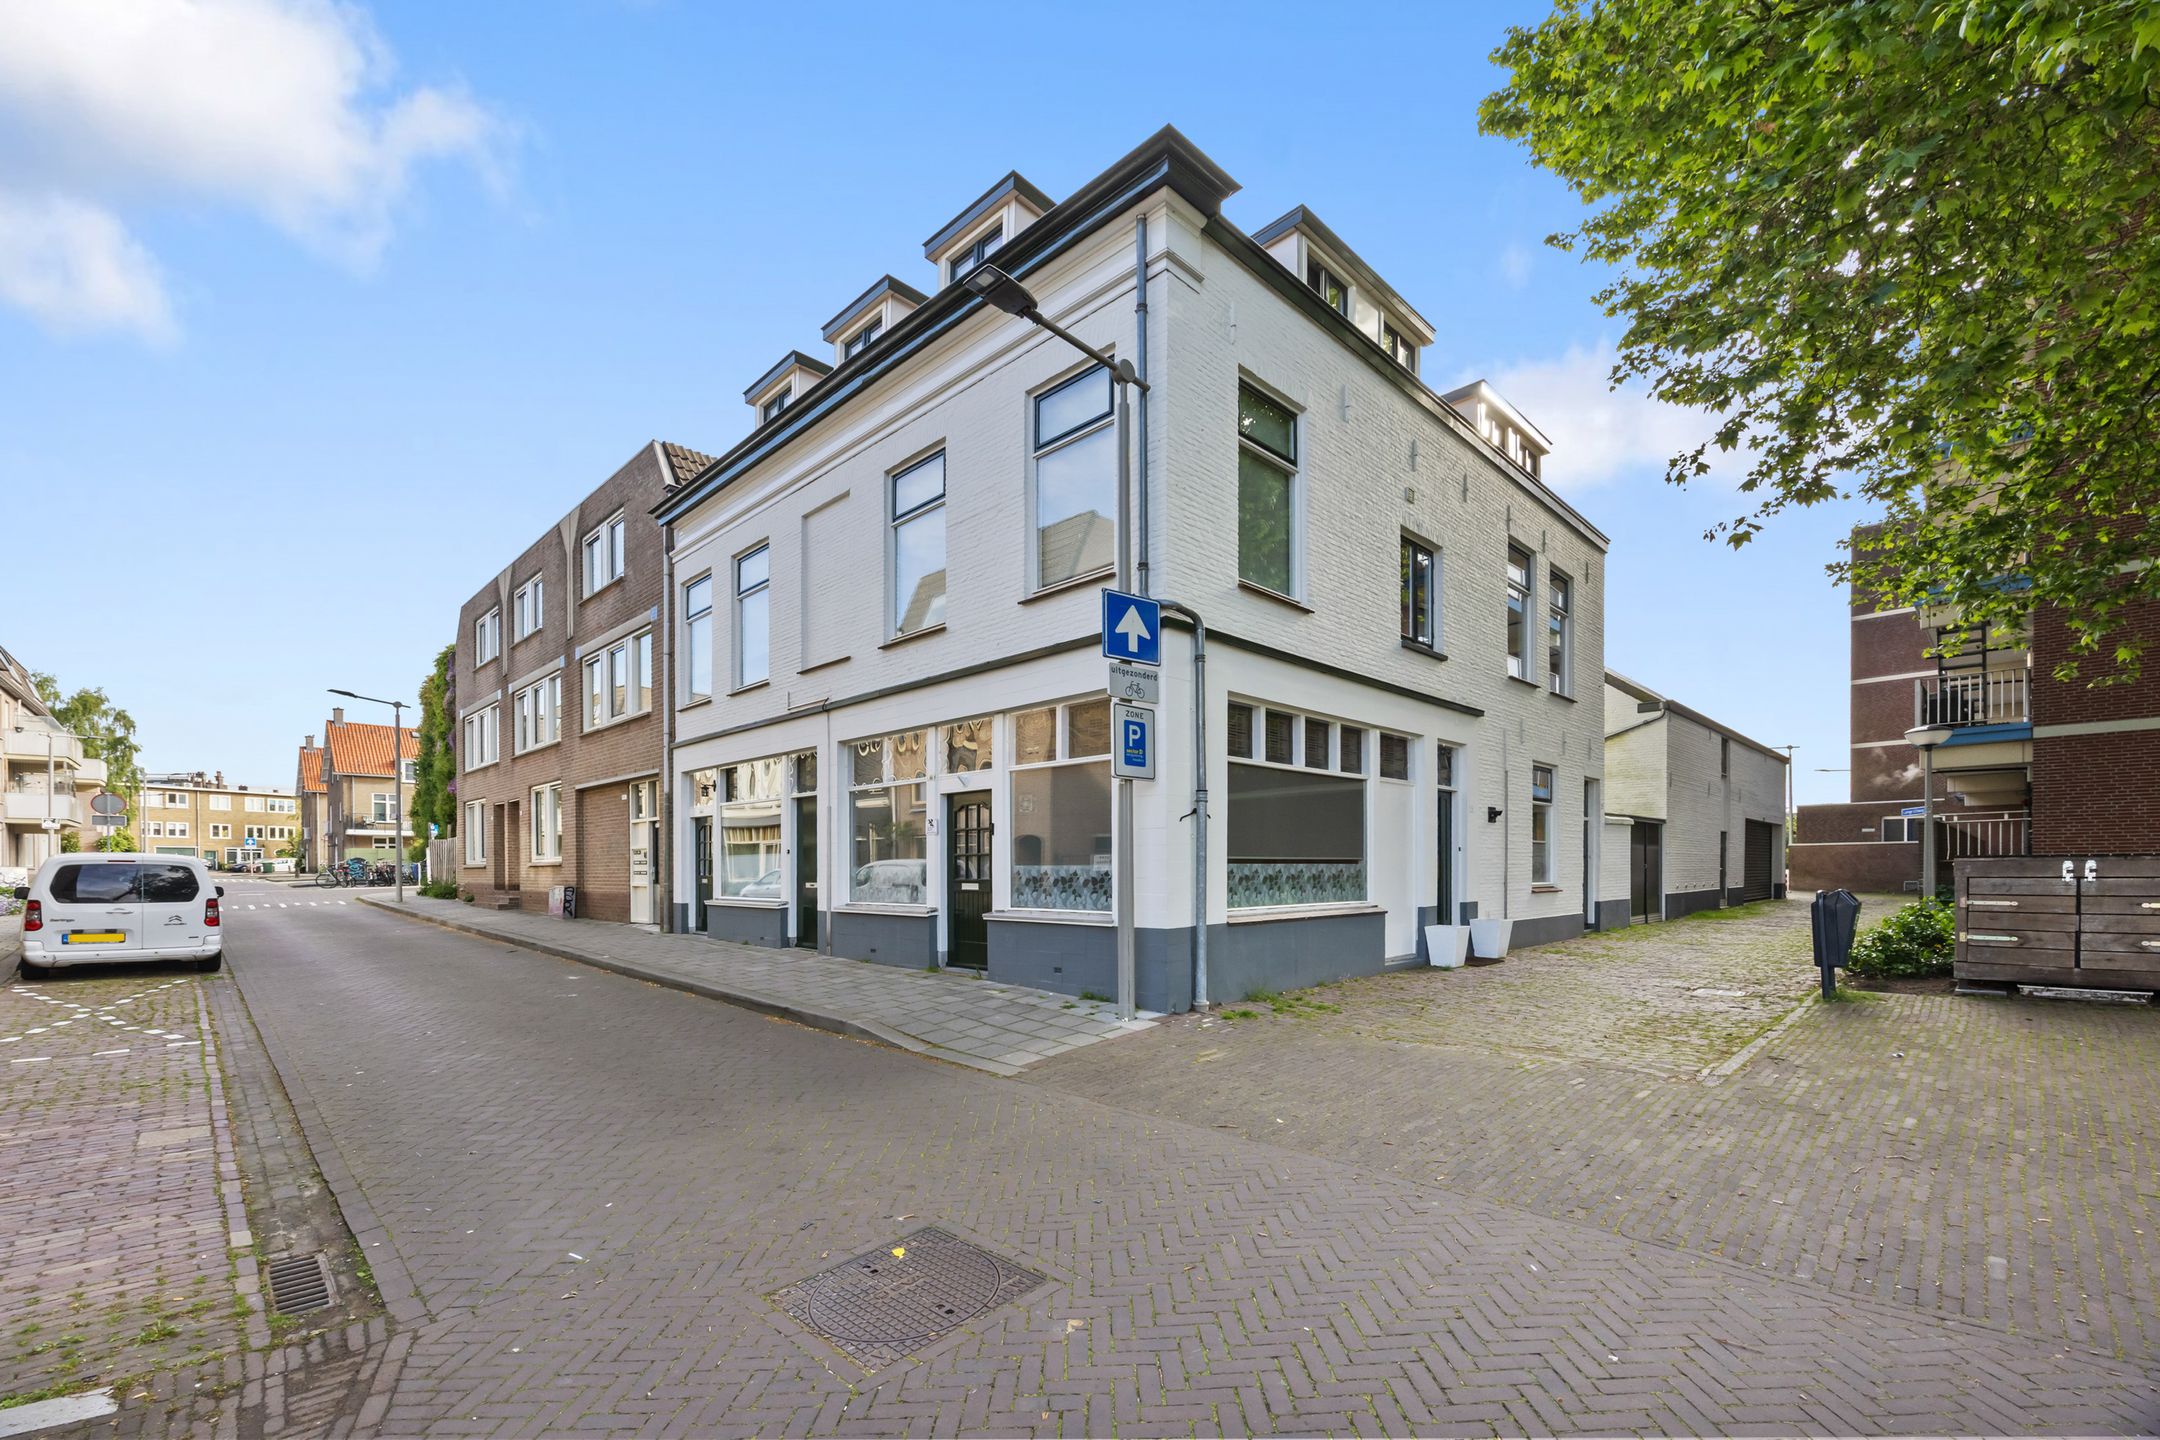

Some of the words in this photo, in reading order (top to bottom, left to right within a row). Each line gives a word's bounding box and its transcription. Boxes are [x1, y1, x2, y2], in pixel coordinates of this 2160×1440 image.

[1111, 666, 1158, 681] uitgezonderd
[1125, 710, 1144, 719] ZONE
[1129, 725, 1141, 746] P
